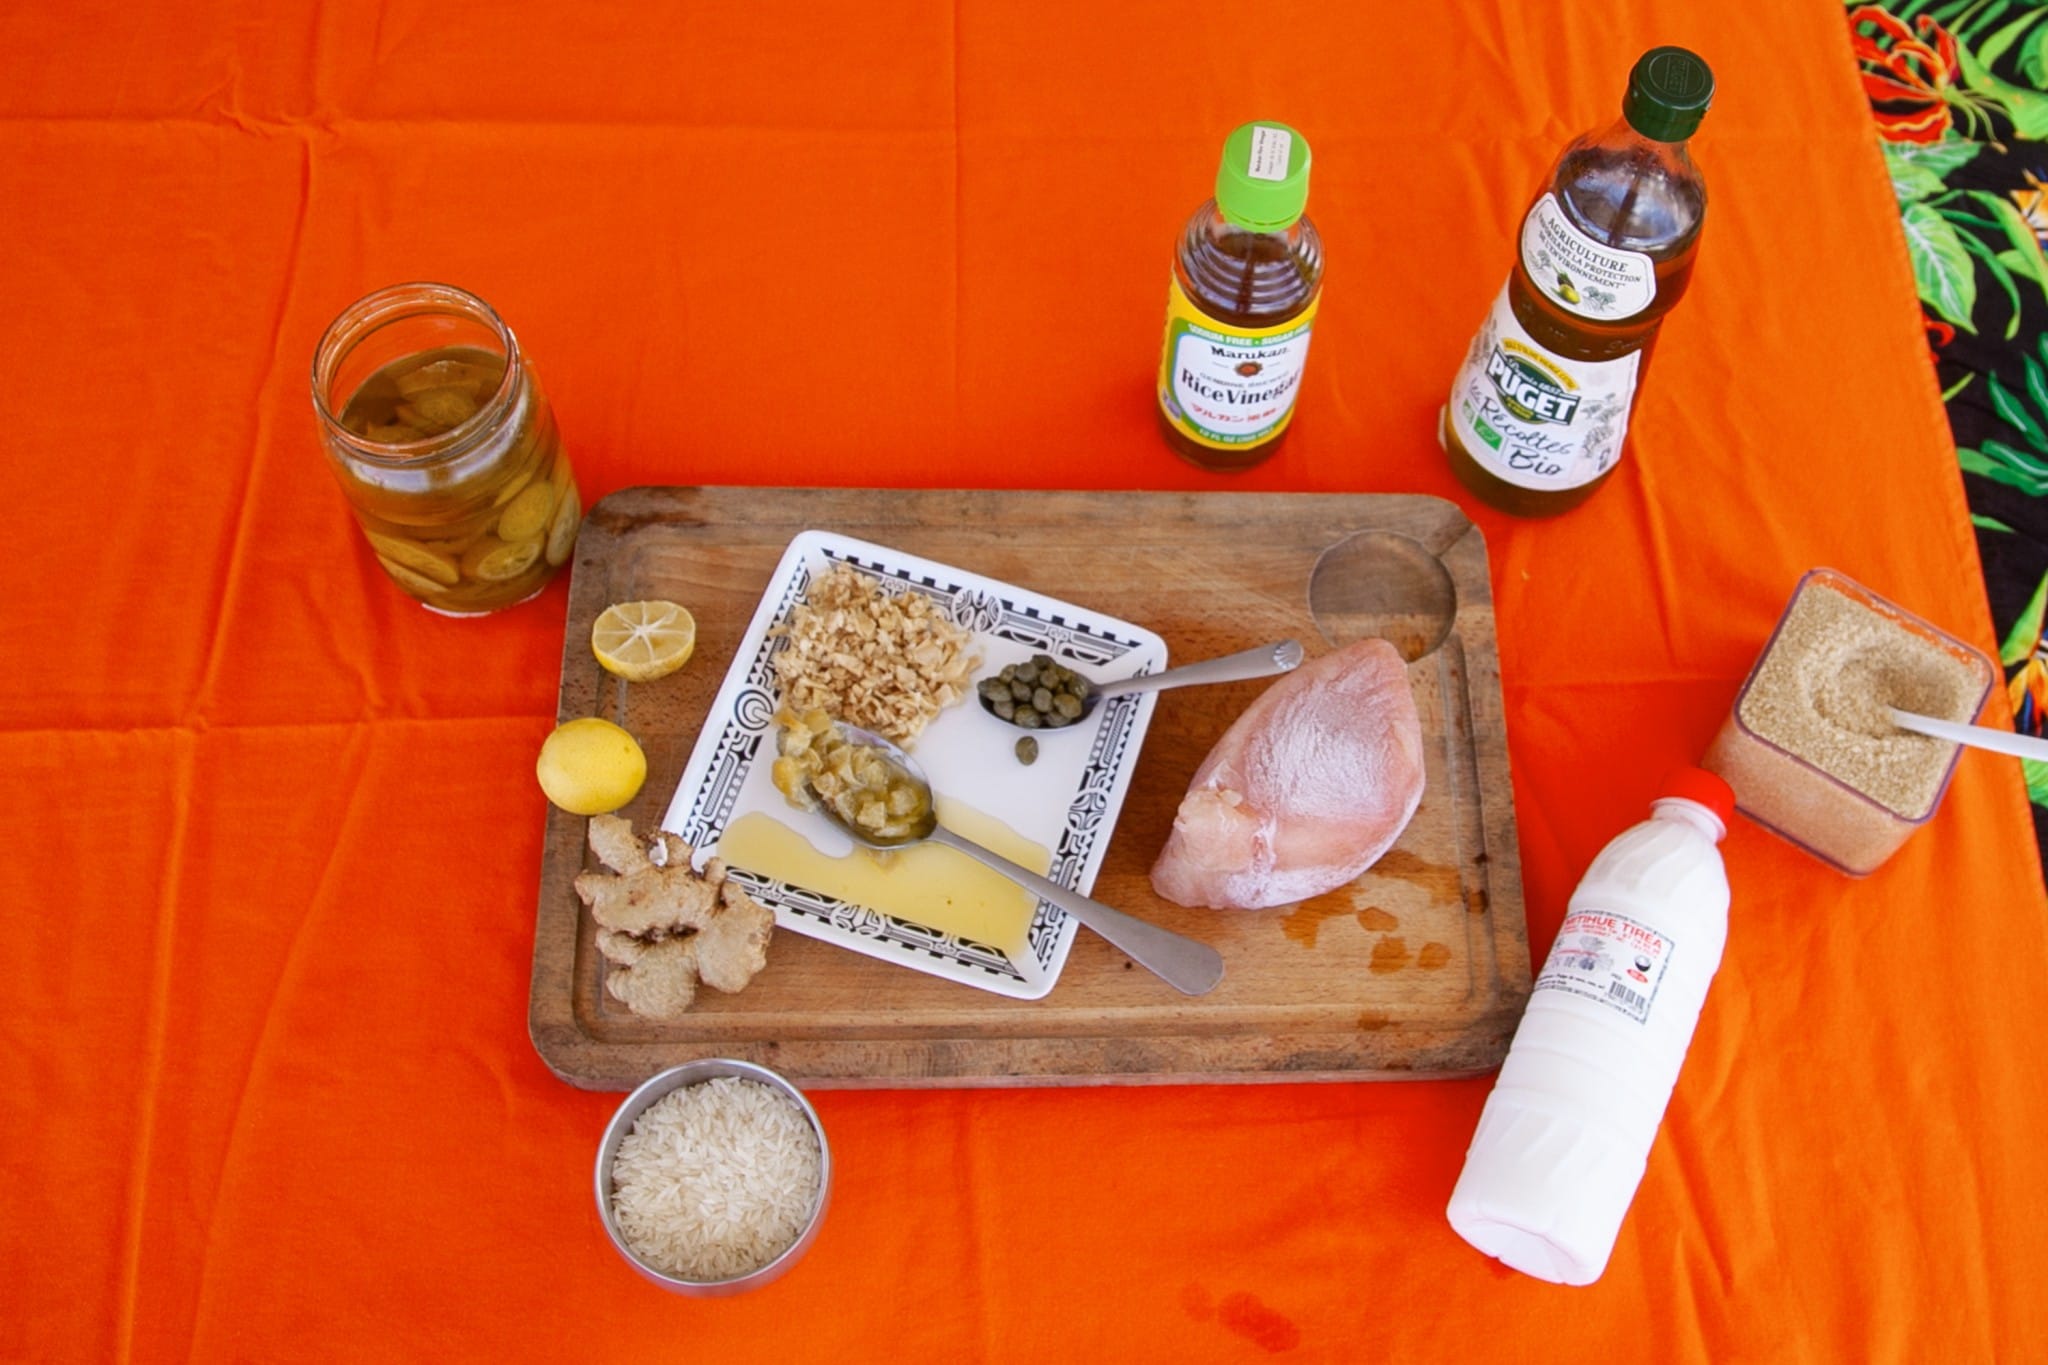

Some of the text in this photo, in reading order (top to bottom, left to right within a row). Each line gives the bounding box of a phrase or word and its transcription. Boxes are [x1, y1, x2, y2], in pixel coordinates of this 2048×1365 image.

[1548, 217, 1629, 273] AGRICULTURE
[1572, 254, 1582, 266] LA
[1584, 260, 1642, 283] PROTECTION
[1211, 345, 1288, 360] Marukan
[1226, 334, 1253, 346] FREE
[1181, 367, 1301, 406] Rice Vinegar
[1488, 353, 1576, 420] PUGET
[1508, 443, 1562, 476] Bio
[1622, 923, 1663, 949] TIREA
